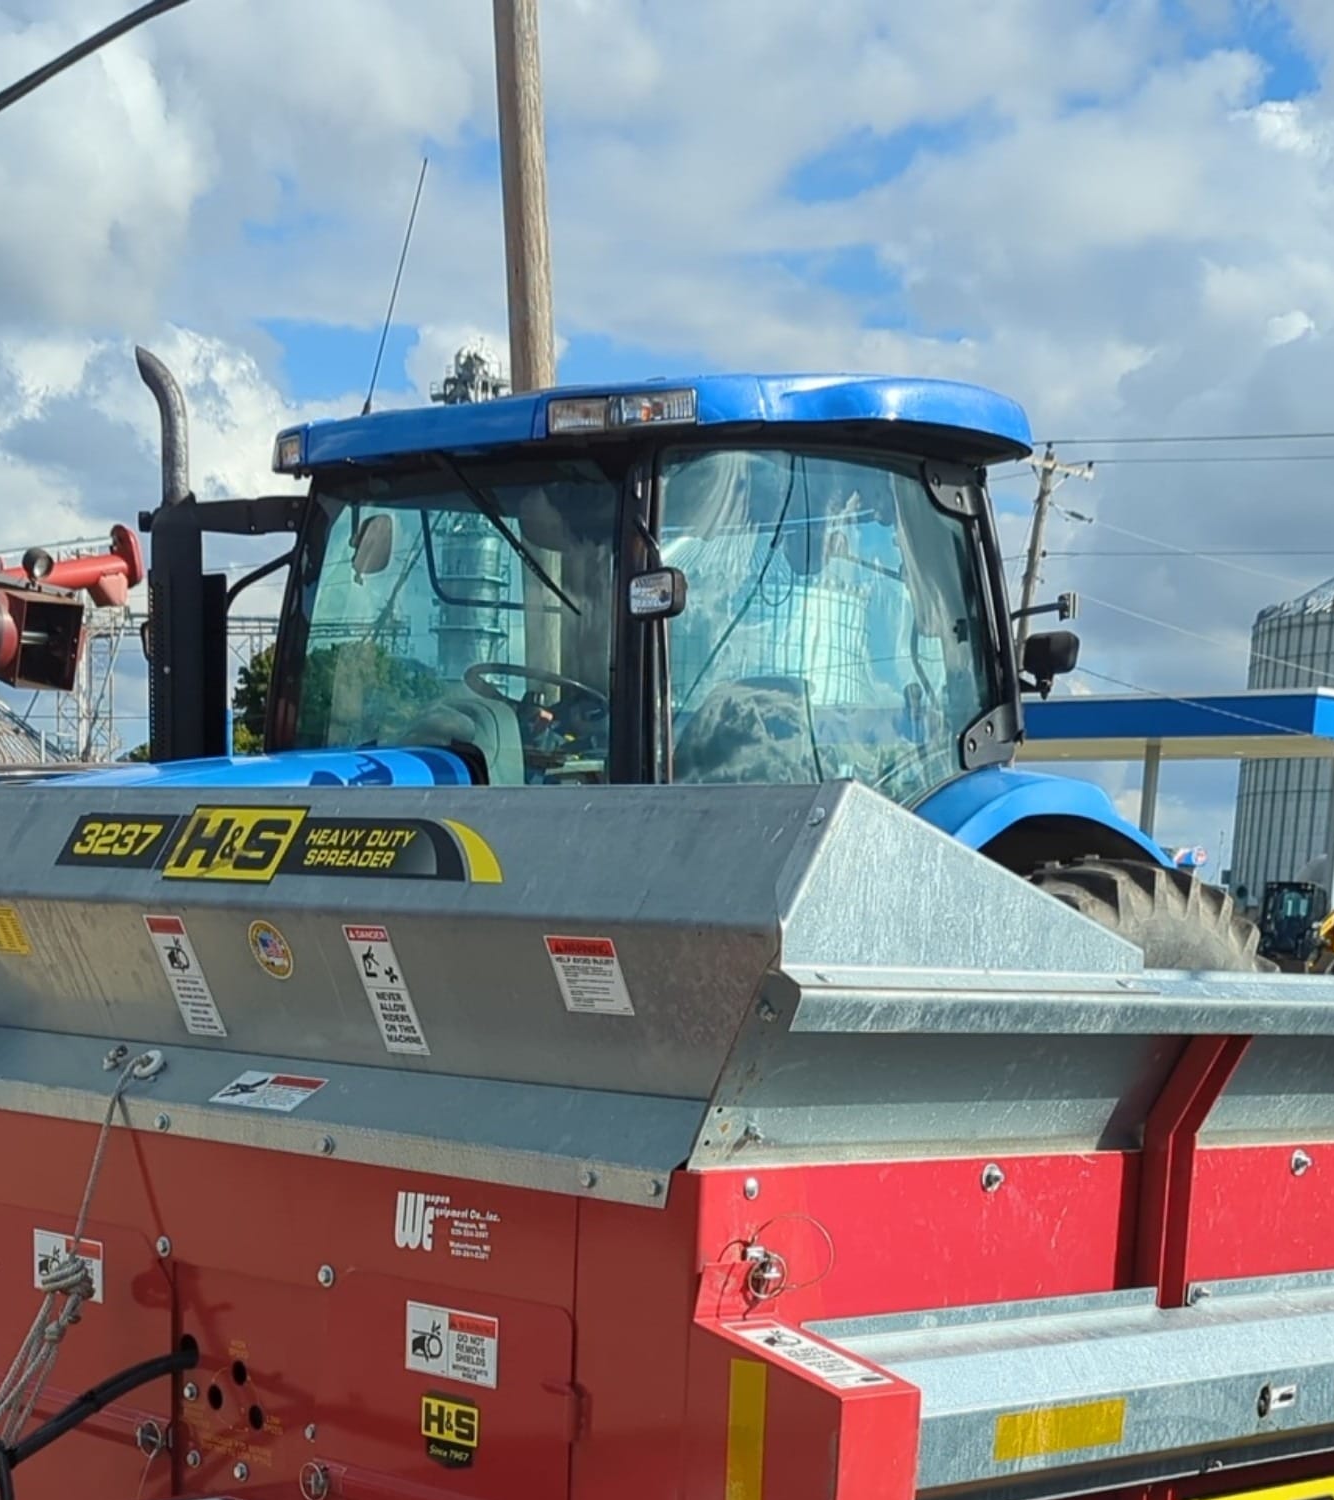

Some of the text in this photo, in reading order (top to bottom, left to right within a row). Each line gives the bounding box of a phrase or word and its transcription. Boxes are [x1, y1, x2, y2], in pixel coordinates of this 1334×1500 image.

[73, 818, 418, 872] 3237 H&S HEAVY DUTY
[303, 849, 396, 869] SPREADER
[376, 991, 403, 1001] NEVER
[379, 1002, 407, 1012] ALLOW
[382, 1013, 412, 1023] RIDERS
[385, 1023, 417, 1034] ON THIS
[387, 1034, 423, 1045] MACHINE
[457, 1335, 485, 1346] DO NOT
[456, 1343, 486, 1357] REMOVE
[455, 1352, 486, 1367] SHIELDS
[424, 1402, 476, 1442] H&S
